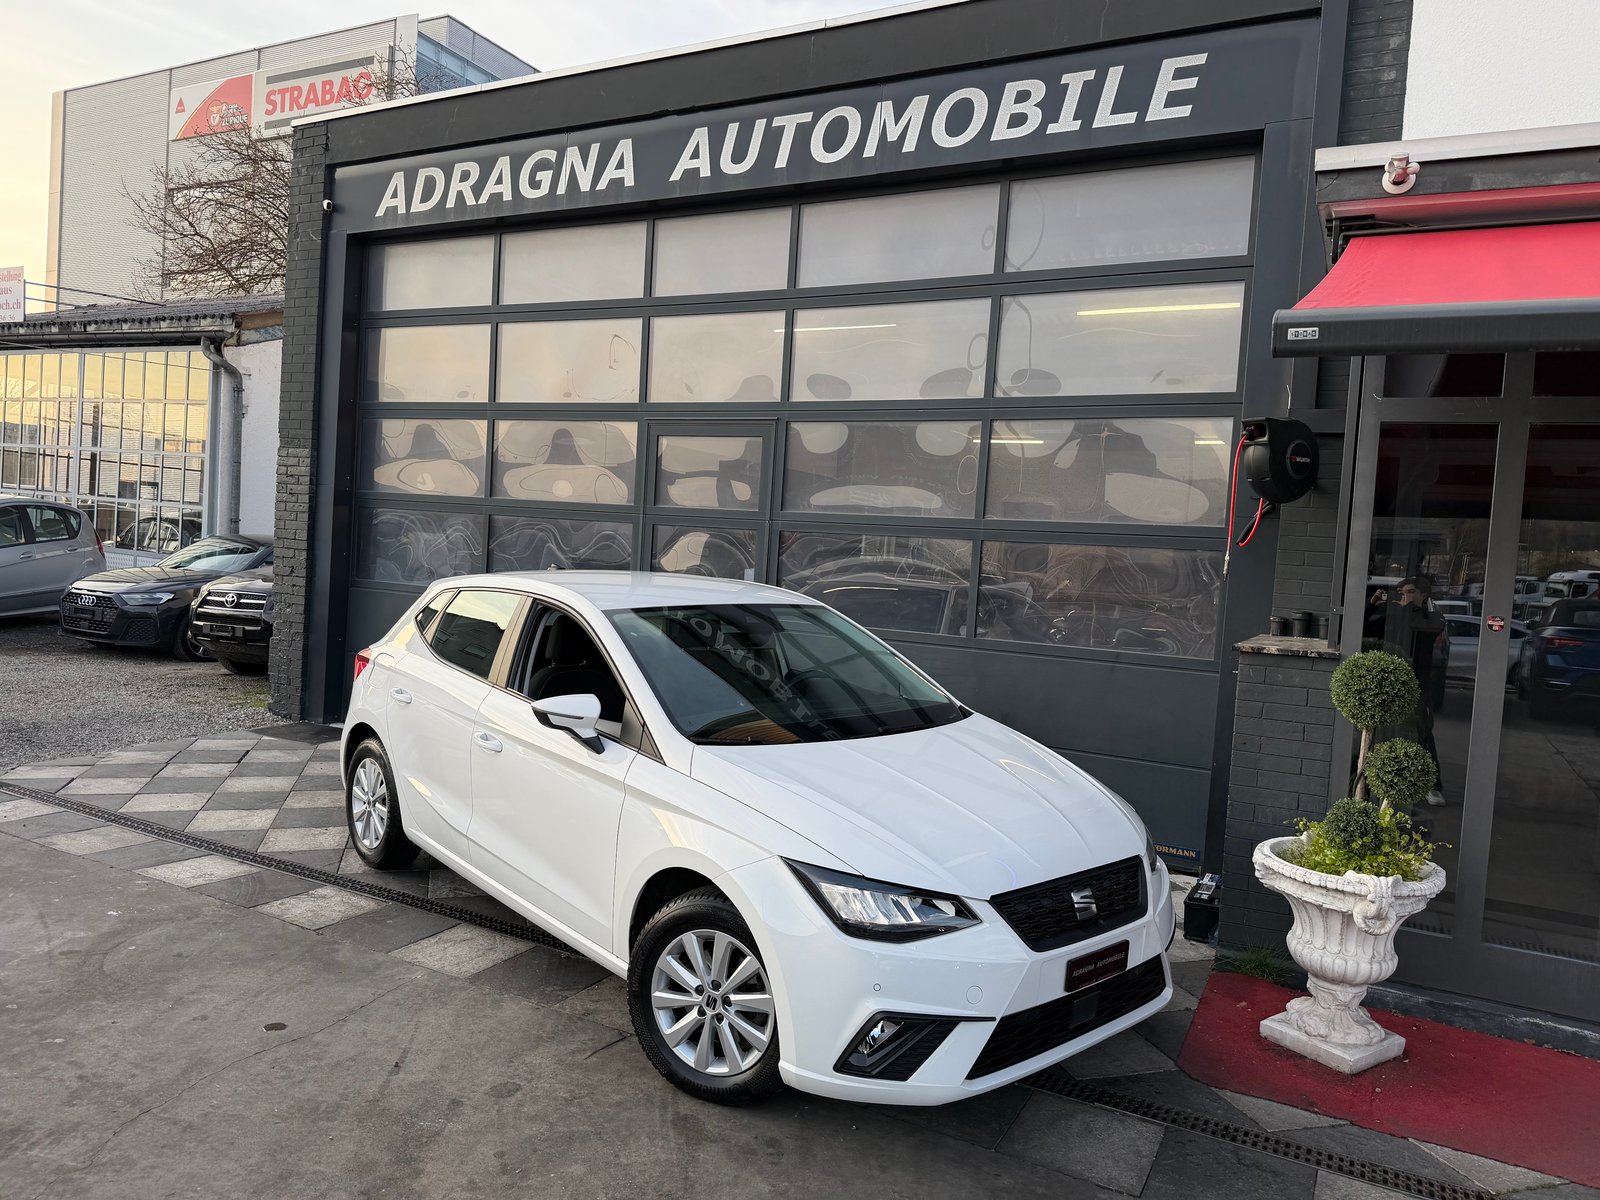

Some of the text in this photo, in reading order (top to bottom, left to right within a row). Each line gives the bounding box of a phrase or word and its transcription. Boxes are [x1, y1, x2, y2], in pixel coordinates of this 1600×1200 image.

[264, 71, 374, 116] STRABAG
[375, 53, 1208, 217] ADRAGNA AUTOMOBILE
